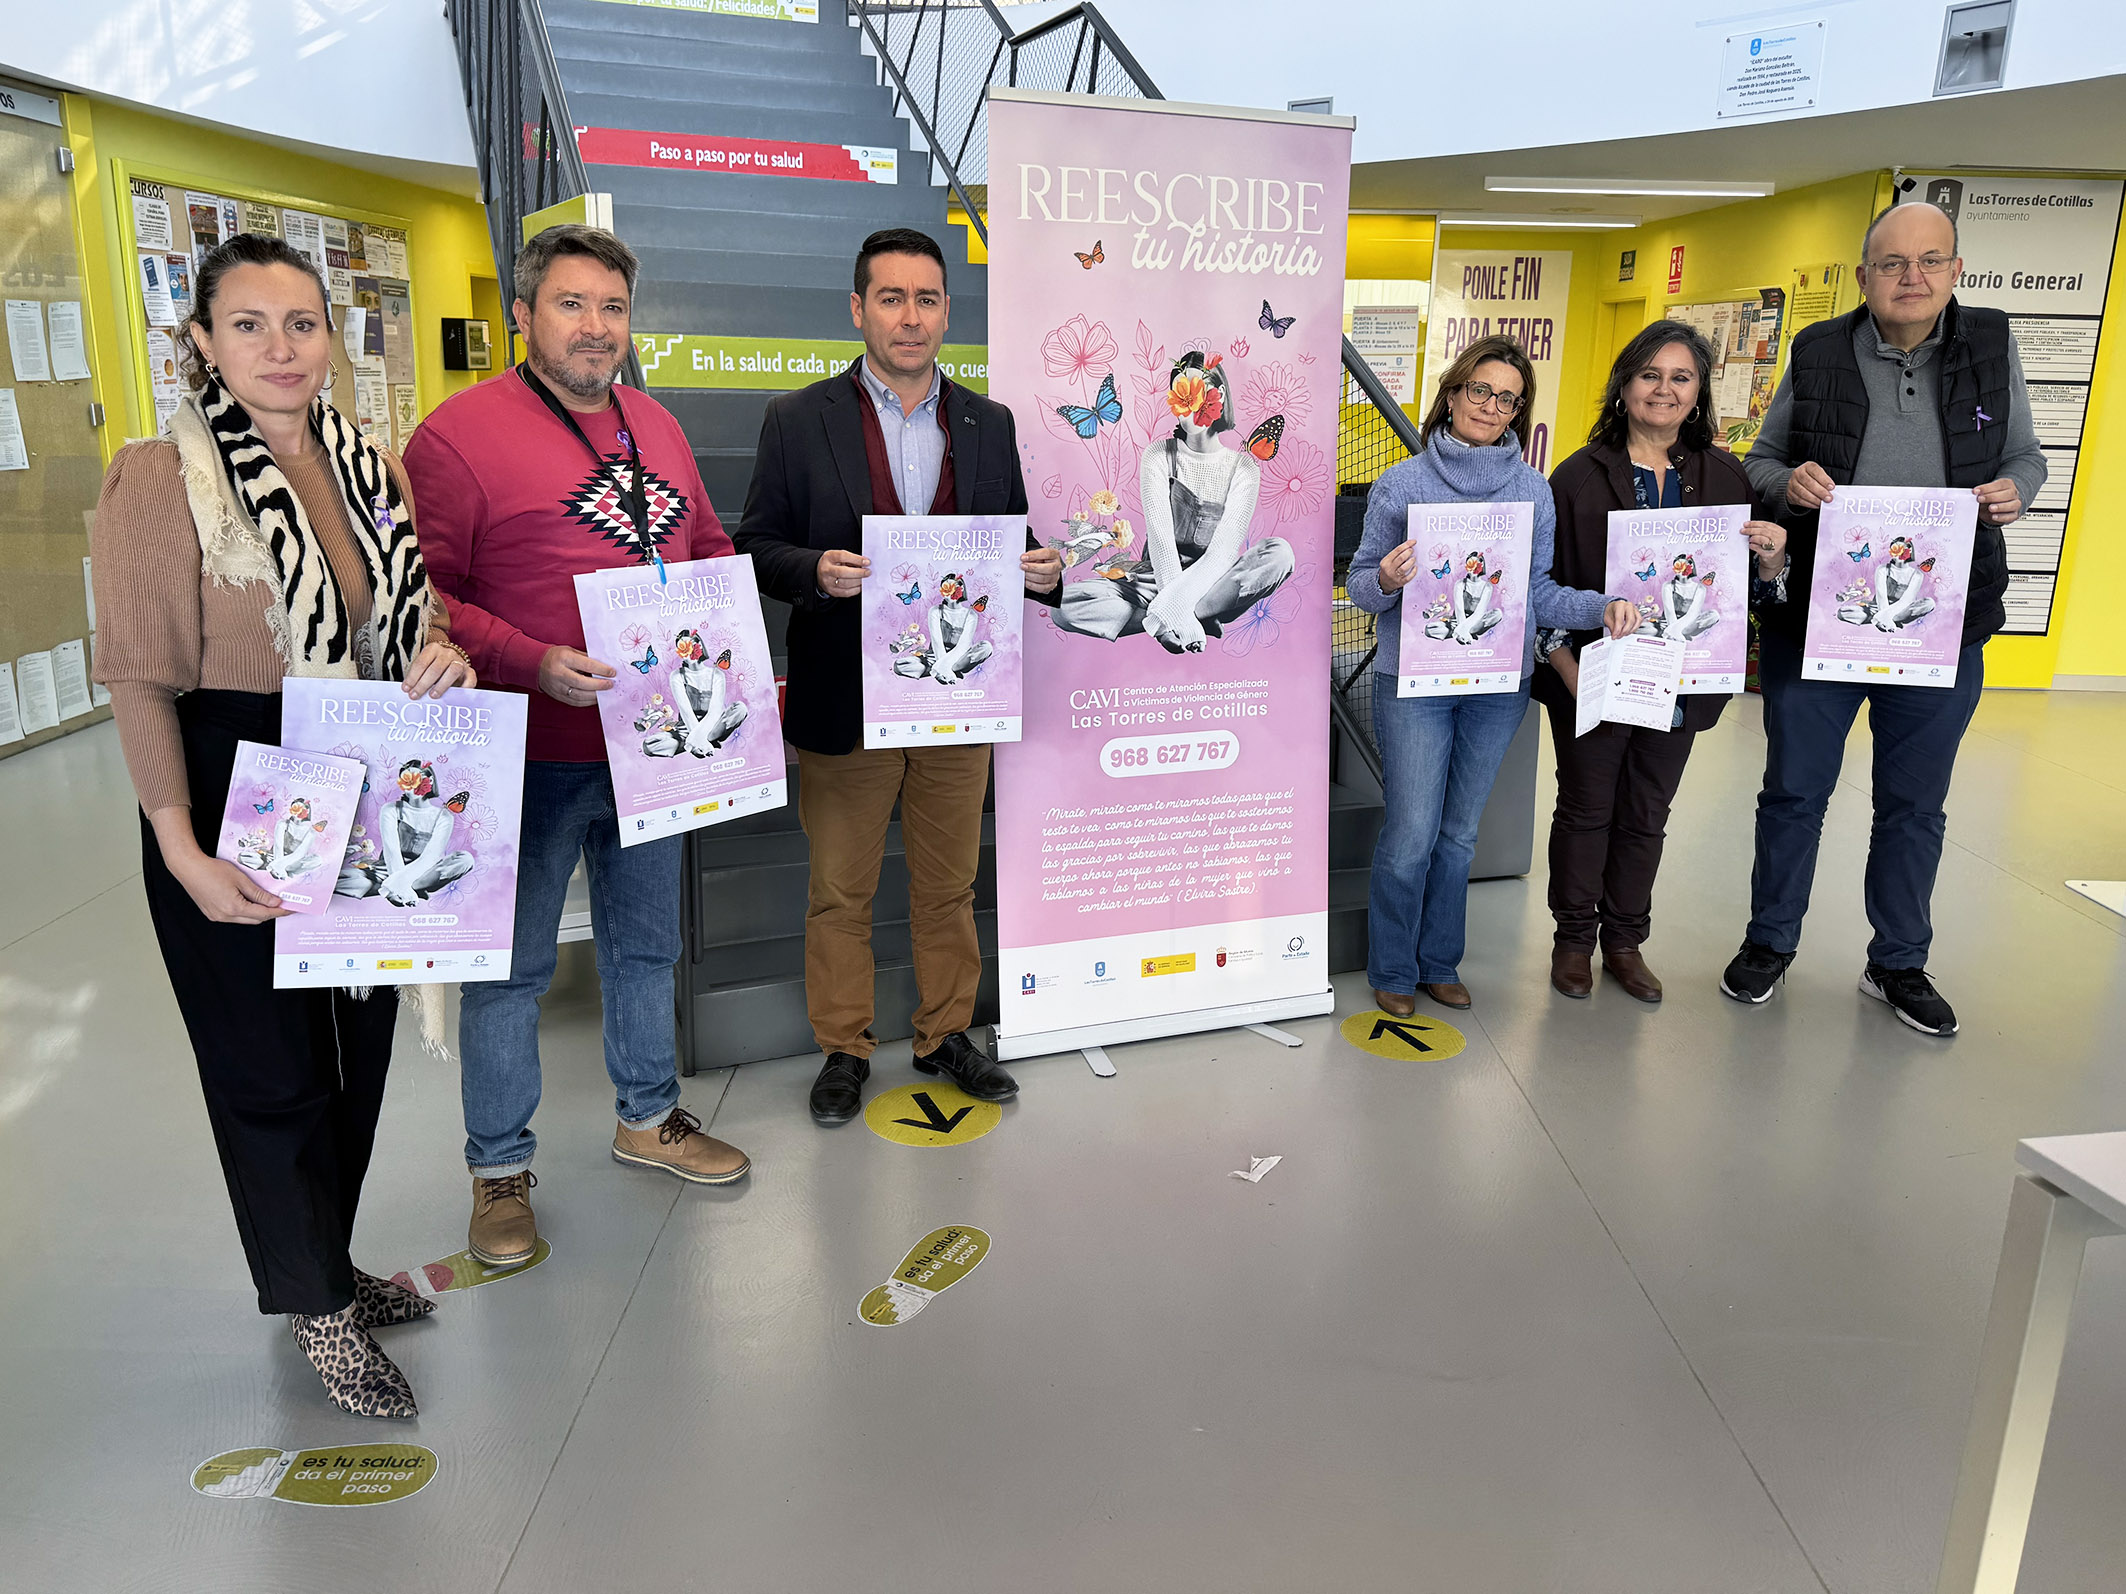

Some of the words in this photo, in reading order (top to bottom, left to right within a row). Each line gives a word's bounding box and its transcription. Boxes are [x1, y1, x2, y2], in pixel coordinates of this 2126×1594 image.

[650, 142, 681, 160] Paso
[684, 149, 693, 160] a
[696, 149, 725, 165] paso
[728, 151, 751, 168] por
[754, 151, 768, 165] tu
[771, 151, 803, 168] salud
[130, 180, 164, 199] CURSOS
[1016, 163, 1325, 235] REESCRIBE
[1966, 212, 2030, 222] ayuntamiento
[1131, 225, 1174, 271] tu
[1173, 222, 1323, 277] historia
[1462, 265, 1508, 300] PONLE
[1511, 257, 1542, 300] FIN
[2011, 272, 2083, 291] General
[692, 350, 714, 370] En
[720, 350, 735, 371] la
[739, 352, 782, 372] salud
[787, 354, 825, 374] cada
[1843, 499, 1955, 517] REESCRIBE
[1884, 514, 1899, 525] tu
[1899, 512, 1953, 527] historia
[1426, 514, 1515, 532] REESCRIBE
[1461, 531, 1474, 541] tu
[1473, 528, 1514, 541] historia
[1628, 517, 1729, 537] REESCRIBE
[887, 530, 1003, 550] REESCRIBE
[1666, 534, 1683, 544] tu
[1681, 532, 1728, 544] historia
[932, 549, 950, 561] tu
[949, 545, 1002, 561] historia
[606, 573, 734, 611] REESCRIBE
[660, 602, 676, 617] tu
[676, 596, 734, 616] historia
[1070, 688, 1120, 710] CAVI
[1123, 687, 1153, 696] Centro
[1156, 685, 1167, 693] de
[1169, 682, 1207, 693] Atención
[1210, 680, 1268, 691] Especializada
[1171, 696, 1182, 704] de
[1184, 693, 1222, 702] Violencia
[1224, 692, 1235, 700] de
[1237, 690, 1268, 699] Género
[319, 698, 493, 732] REESCRIBE
[1071, 715, 1102, 728] Las
[1108, 711, 1166, 726] Torres
[1172, 707, 1193, 721] de
[1200, 702, 1268, 719] Cotillas
[387, 724, 411, 742] tu
[411, 722, 491, 747] historia
[1111, 747, 1148, 768] 968
[1156, 744, 1190, 764] 627
[1197, 741, 1230, 760] 767
[256, 752, 351, 784] REESCRIBE
[290, 773, 303, 783] tu
[302, 773, 347, 792] historia
[1127, 803, 1153, 812] como
[1155, 800, 1165, 809] te
[1166, 799, 1211, 808] miramos
[1211, 792, 1238, 804] todas
[1237, 792, 1263, 806] para
[1265, 791, 1283, 806] que
[1284, 787, 1294, 798] el
[1042, 826, 1068, 836] resto
[1070, 823, 1080, 833] te
[1105, 822, 1132, 831] como
[1134, 818, 1144, 827] te
[1145, 816, 1190, 827] miramos
[1191, 811, 1206, 822] las
[1208, 812, 1226, 827] que
[1227, 809, 1236, 818] te
[1238, 805, 1293, 817] sostenemos
[1042, 841, 1053, 853] la
[1056, 837, 1095, 855] espalda
[1095, 838, 1123, 851] para
[1124, 833, 1156, 848] seguir
[1158, 832, 1169, 841] tu
[1213, 824, 1228, 835] las
[1230, 824, 1248, 840] que
[1249, 823, 1258, 832] te
[1260, 820, 1293, 831] damos
[1042, 857, 1060, 869] las
[1061, 855, 1103, 872] gracias
[1103, 853, 1124, 867] por
[1183, 843, 1199, 854] las
[1202, 844, 1220, 859] que
[1223, 837, 1279, 850] abrazamos
[1282, 835, 1293, 844] tu
[1042, 874, 1078, 887] cuerpo
[1082, 868, 1114, 880] ahora
[1114, 865, 1152, 881] porque
[1155, 862, 1182, 873] antes
[1186, 861, 1199, 869] no
[1256, 851, 1271, 862] las
[1274, 852, 1292, 866] que
[1042, 887, 1094, 901] hablamos
[1113, 882, 1129, 893] las
[1169, 875, 1181, 887] de
[1186, 873, 1197, 885] la
[1201, 872, 1231, 887] mujer
[1235, 871, 1253, 885] que
[1258, 868, 1279, 877] vino
[1078, 899, 1122, 912] cambiar
[1124, 896, 1134, 907] el
[905, 1266, 921, 1278] es
[915, 1256, 933, 1266] tu
[929, 1229, 961, 1255] salud:
[918, 1270, 935, 1282] da
[932, 1260, 944, 1270] el
[941, 1234, 972, 1261] primer
[954, 1244, 978, 1265] paso
[303, 1457, 328, 1468] es
[333, 1456, 355, 1468] tu
[359, 1455, 426, 1468] salud:
[294, 1469, 320, 1480] da
[326, 1469, 343, 1480] el
[349, 1470, 414, 1482] primer
[341, 1483, 392, 1496] paso
